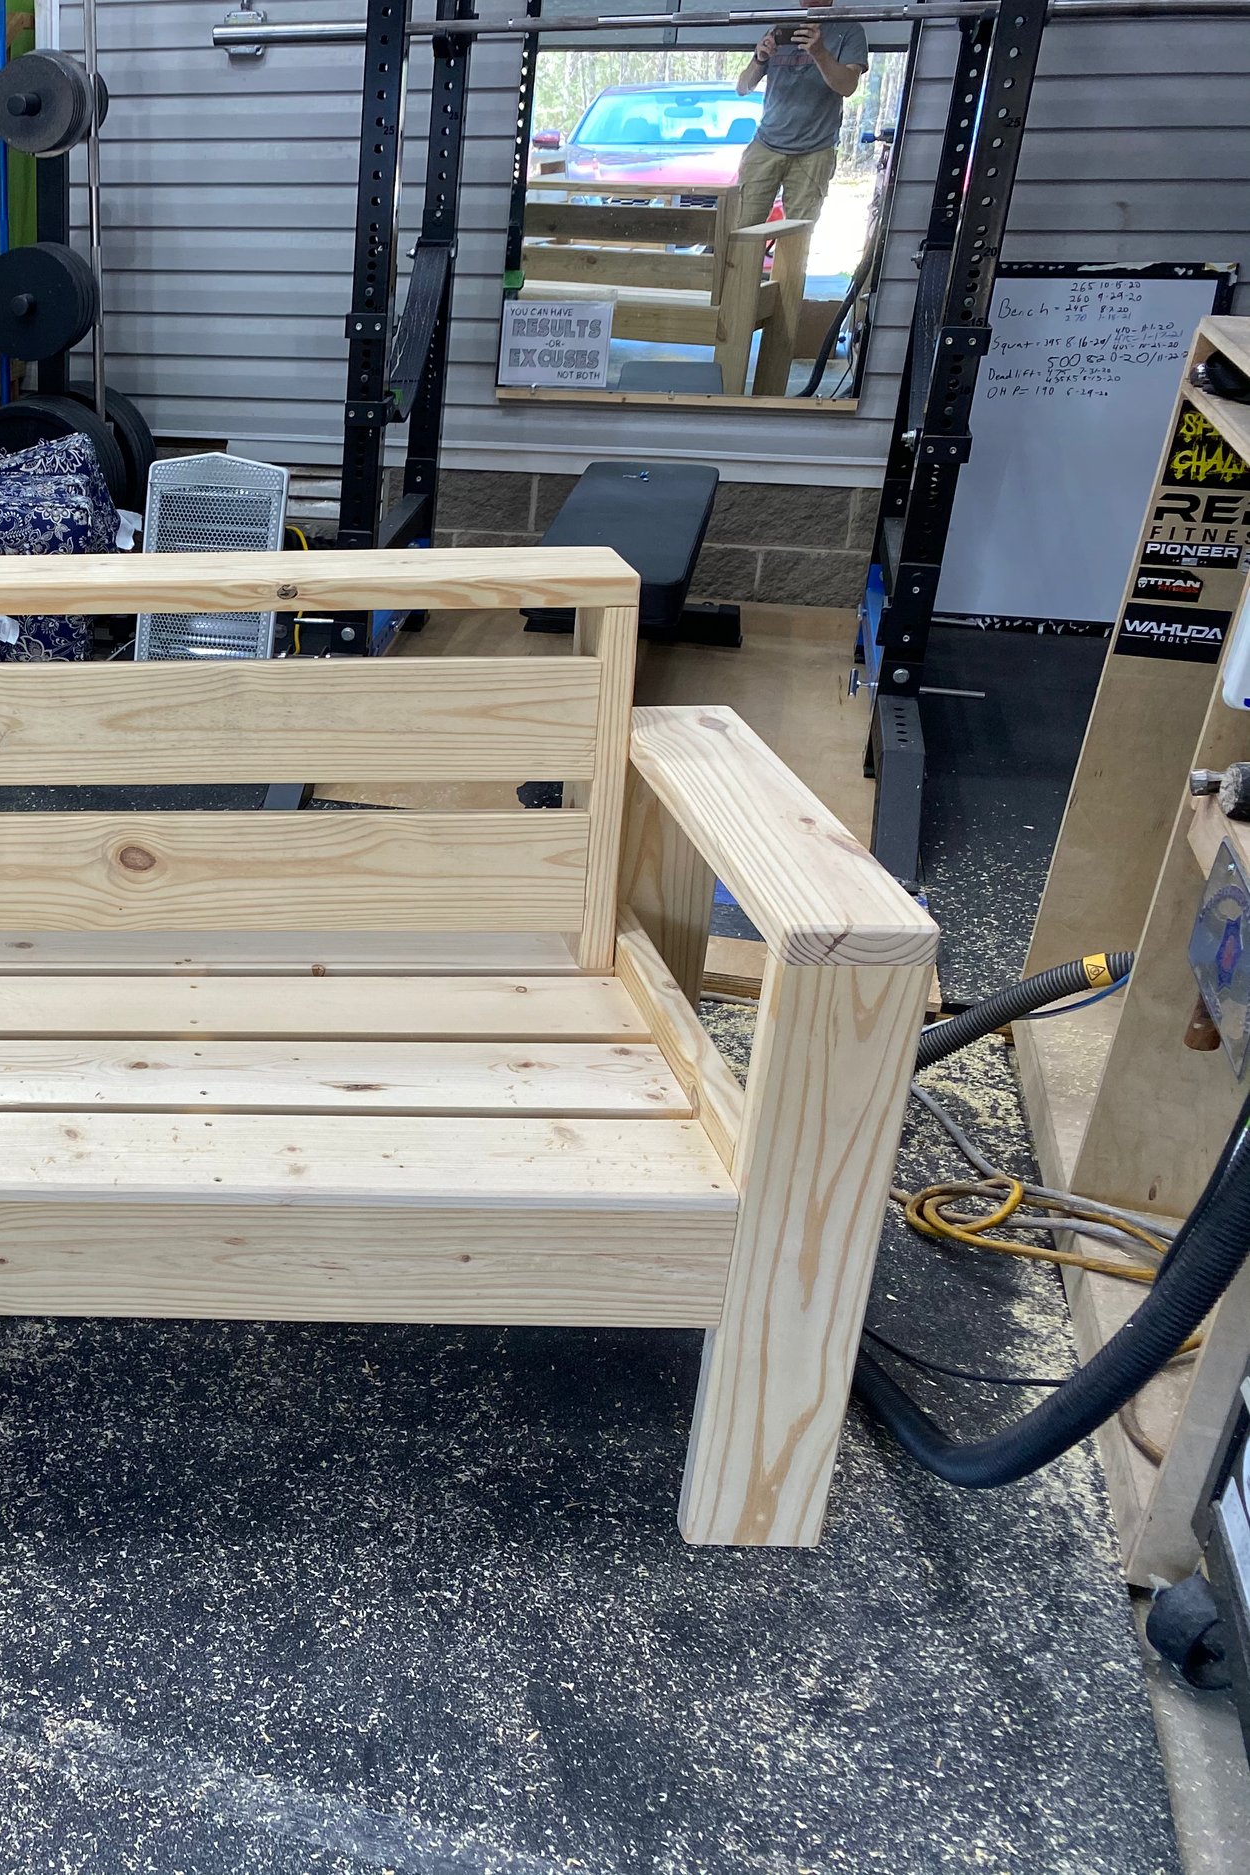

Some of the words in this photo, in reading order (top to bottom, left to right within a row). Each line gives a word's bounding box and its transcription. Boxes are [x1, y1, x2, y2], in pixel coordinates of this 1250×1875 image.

[1007, 118, 1021, 128] 25
[383, 126, 395, 135] 25
[984, 247, 998, 258] 20
[1070, 281, 1096, 293] 265
[1069, 294, 1090, 303] 260
[510, 307, 528, 316] YOU
[530, 308, 549, 316] CAN
[550, 308, 574, 317] HAVE
[999, 297, 1049, 319] Bench
[971, 317, 984, 328] 15
[1064, 313, 1088, 323] 270
[511, 318, 602, 338] RESULTS
[508, 348, 600, 369] EXCUSES
[1047, 353, 1081, 369] 500
[557, 371, 575, 379] NOT
[576, 371, 601, 380] BOTH
[1034, 386, 1055, 396] 190
[1145, 542, 1240, 558] PIONEER
[1147, 577, 1202, 588] TITAN
[1123, 619, 1223, 640] WAHUDA
[1152, 634, 1189, 645] TOOLS
